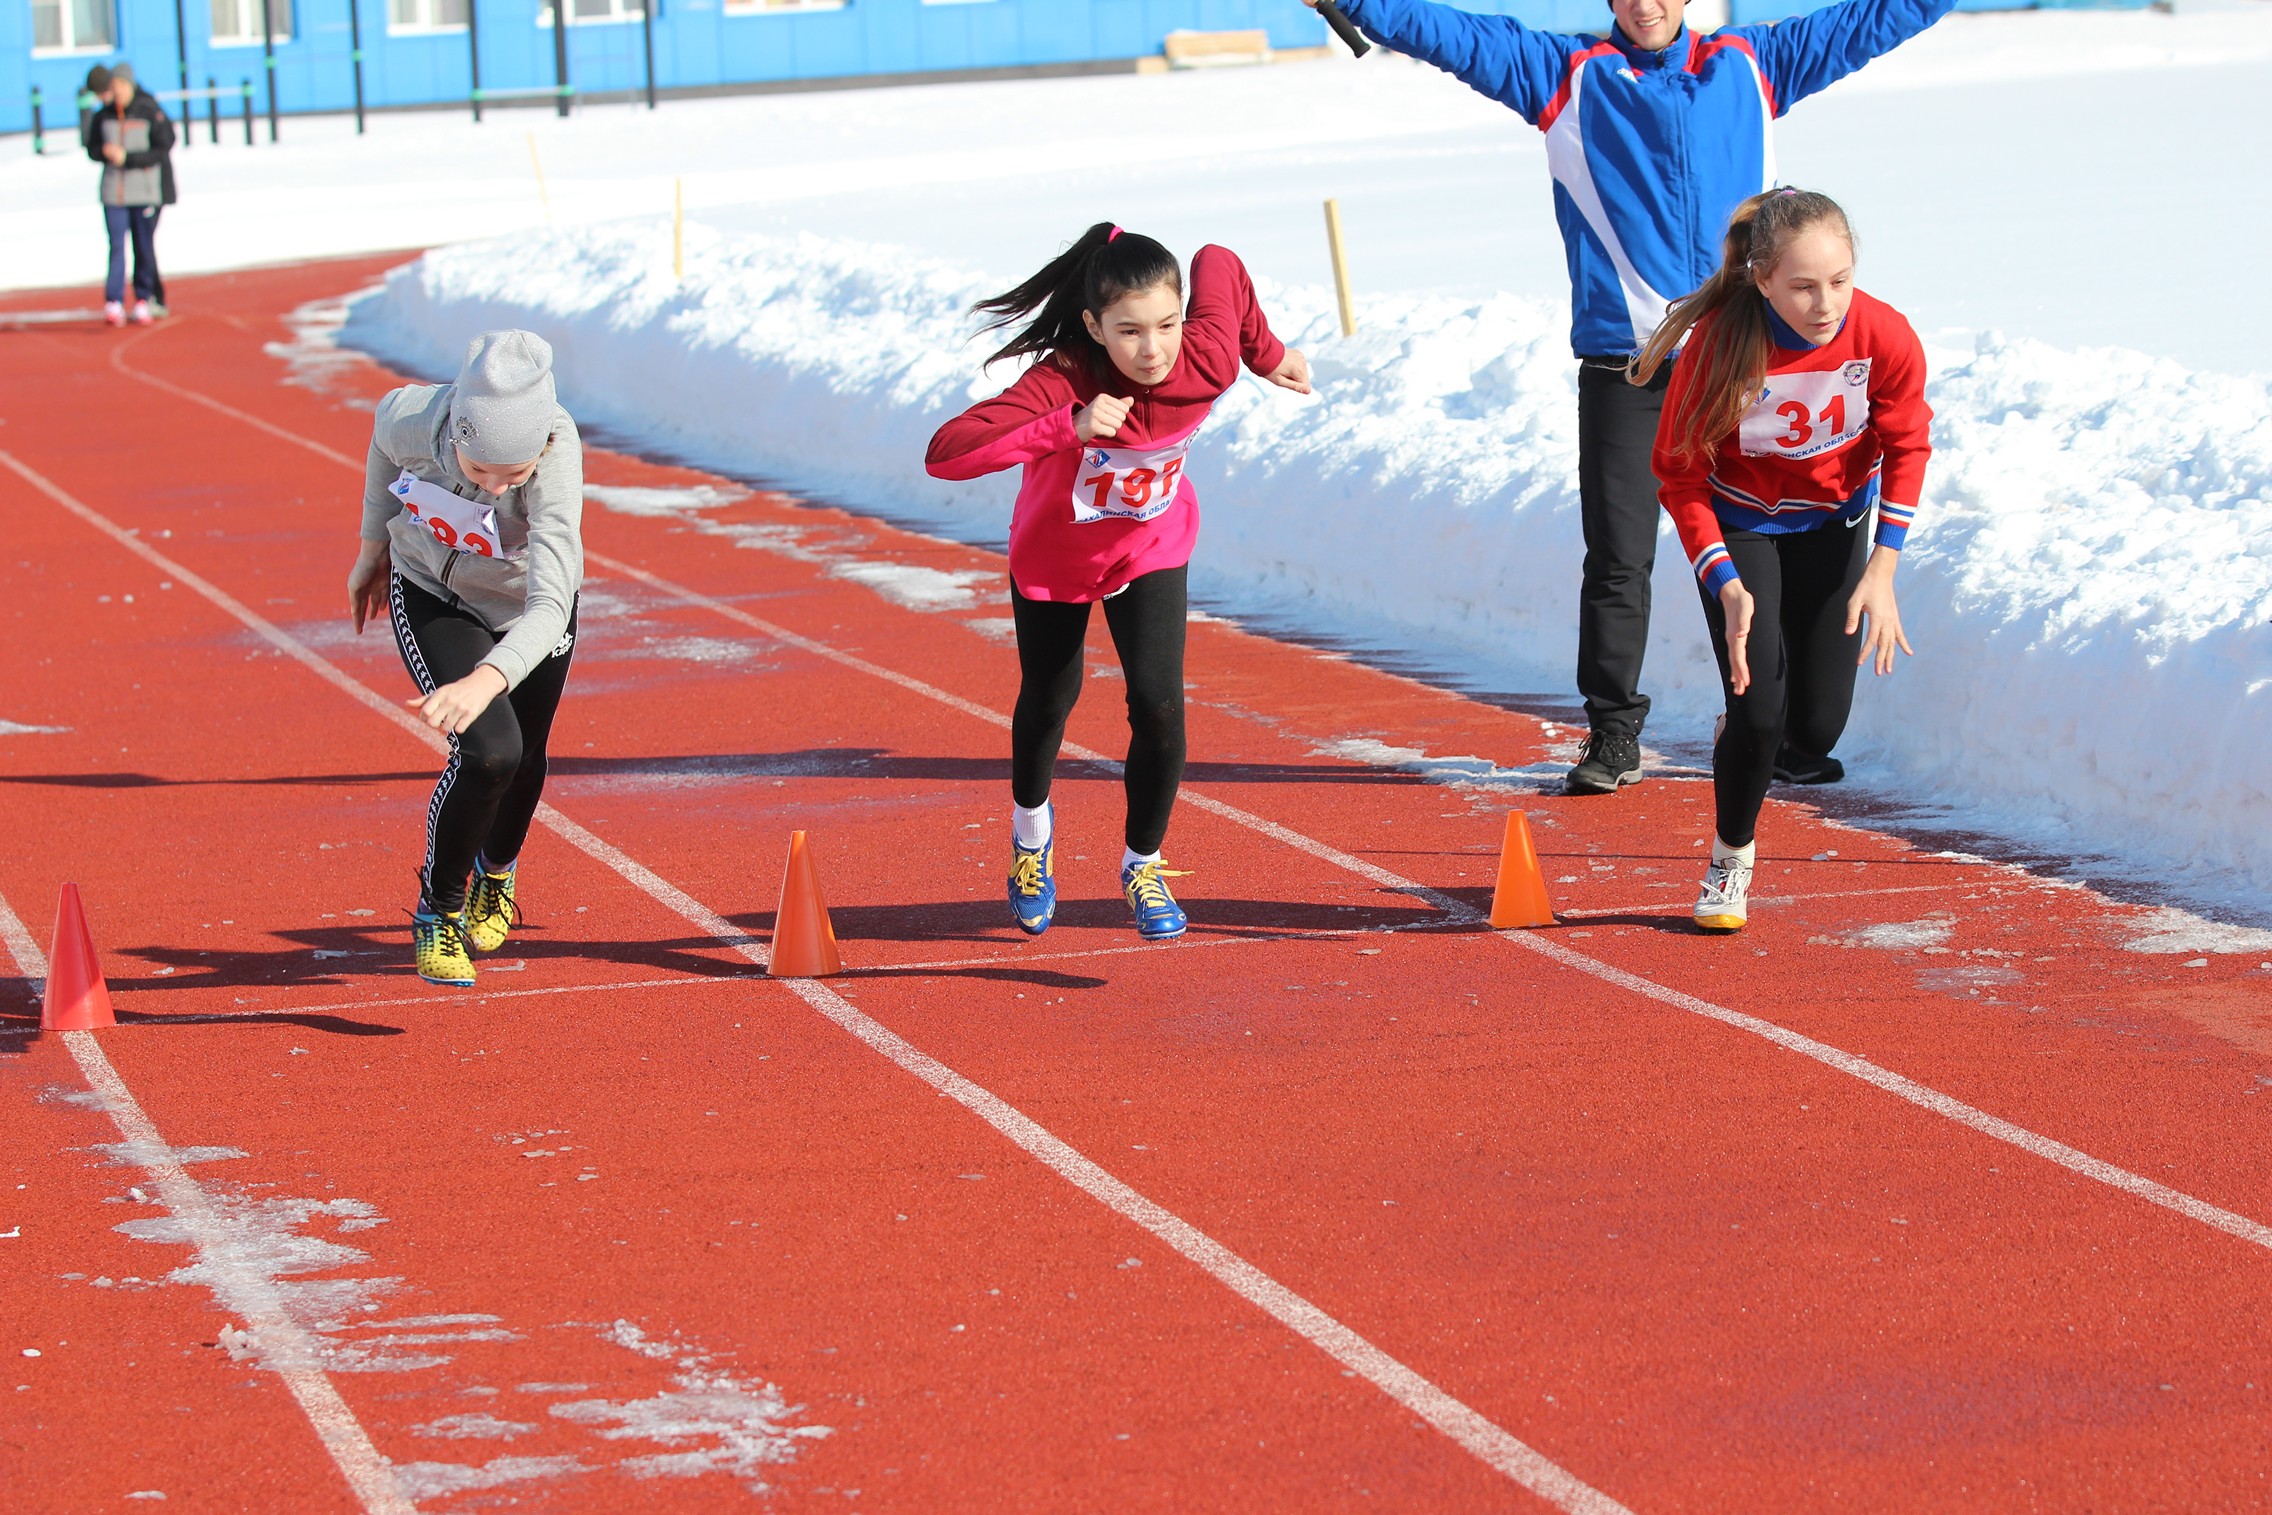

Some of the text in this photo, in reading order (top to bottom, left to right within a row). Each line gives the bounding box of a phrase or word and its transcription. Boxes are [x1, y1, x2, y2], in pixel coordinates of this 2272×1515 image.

[1775, 394, 1845, 448] 31
[1084, 456, 1183, 508] 197
[1149, 498, 1172, 515] ОБЛА
